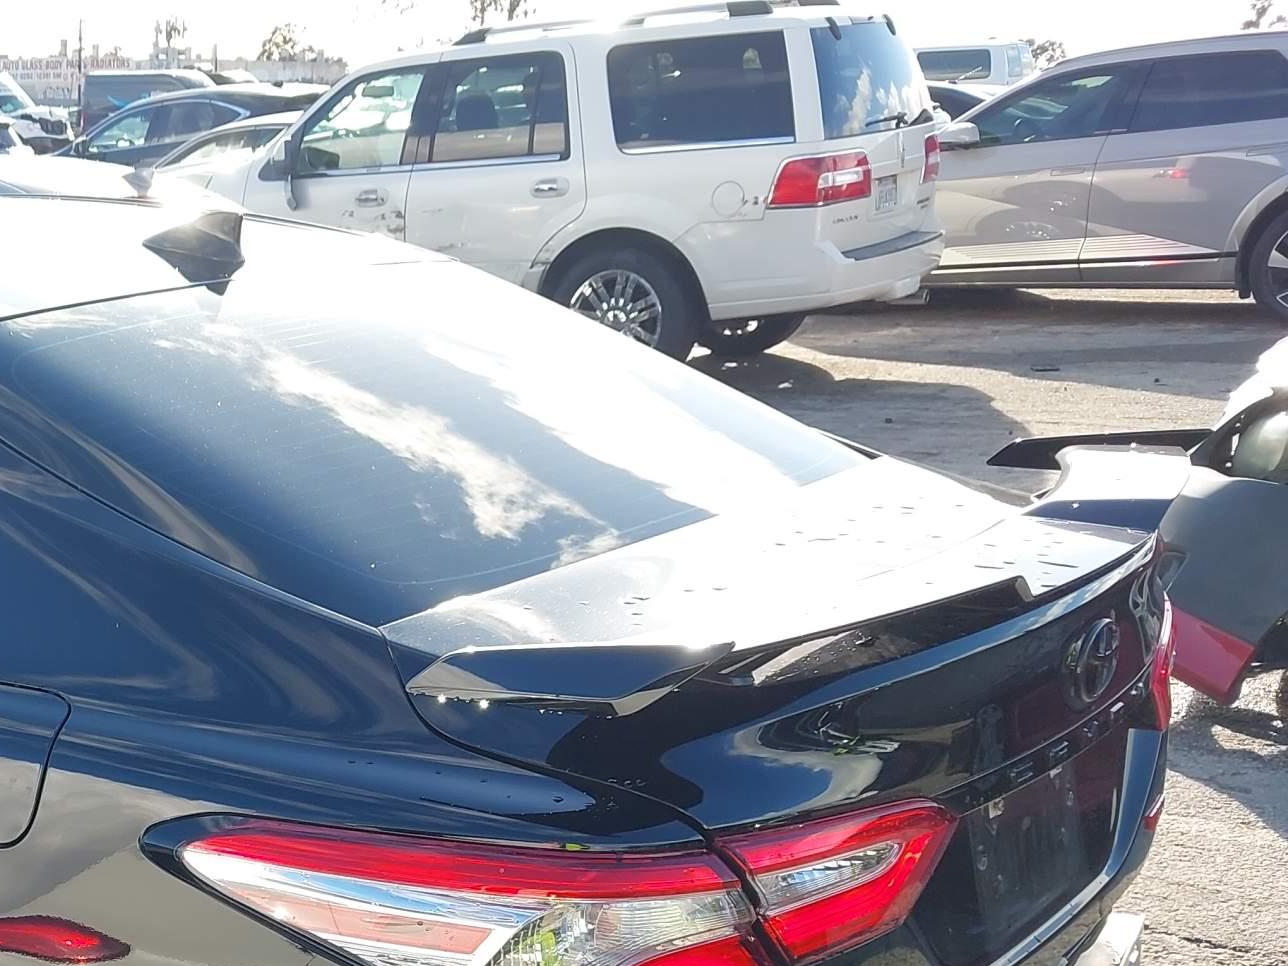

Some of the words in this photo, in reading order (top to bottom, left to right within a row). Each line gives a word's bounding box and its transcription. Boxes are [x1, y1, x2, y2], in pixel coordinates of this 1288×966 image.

[22, 60, 43, 70] GLASS
[45, 60, 63, 70] BODY
[66, 59, 88, 70] PARS
[90, 58, 130, 69] RADIATORS
